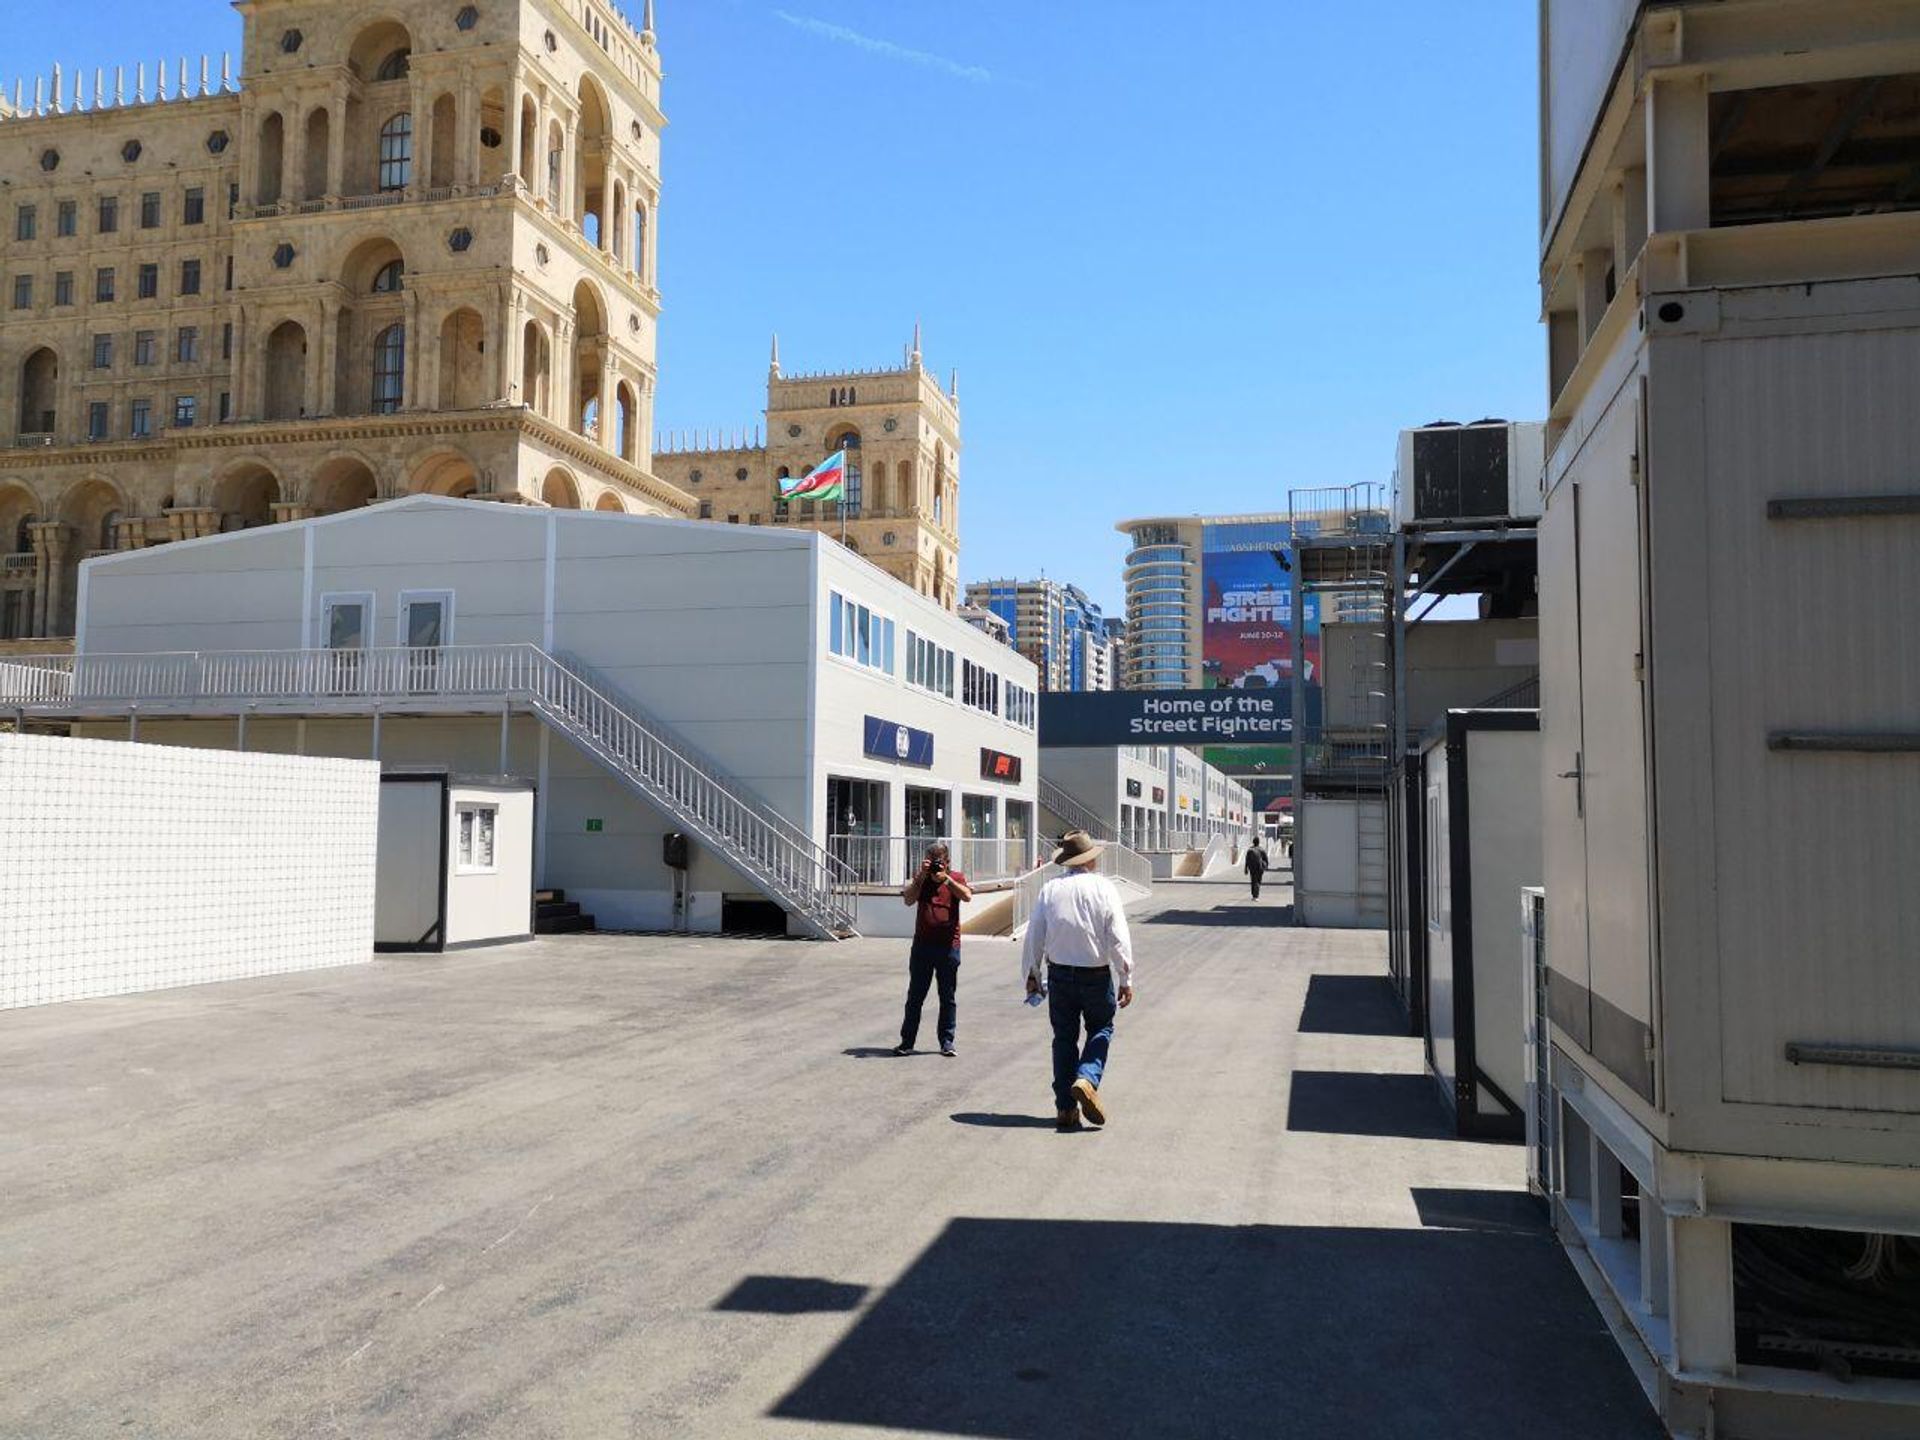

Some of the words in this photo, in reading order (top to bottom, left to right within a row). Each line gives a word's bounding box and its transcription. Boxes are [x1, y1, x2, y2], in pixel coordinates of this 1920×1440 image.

[1240, 631, 1260, 639] JUNE
[1143, 699, 1206, 714] Home
[1210, 697, 1233, 712] of
[1237, 697, 1274, 712] the
[1130, 717, 1198, 733] Street
[1201, 716, 1293, 735] Fighters
